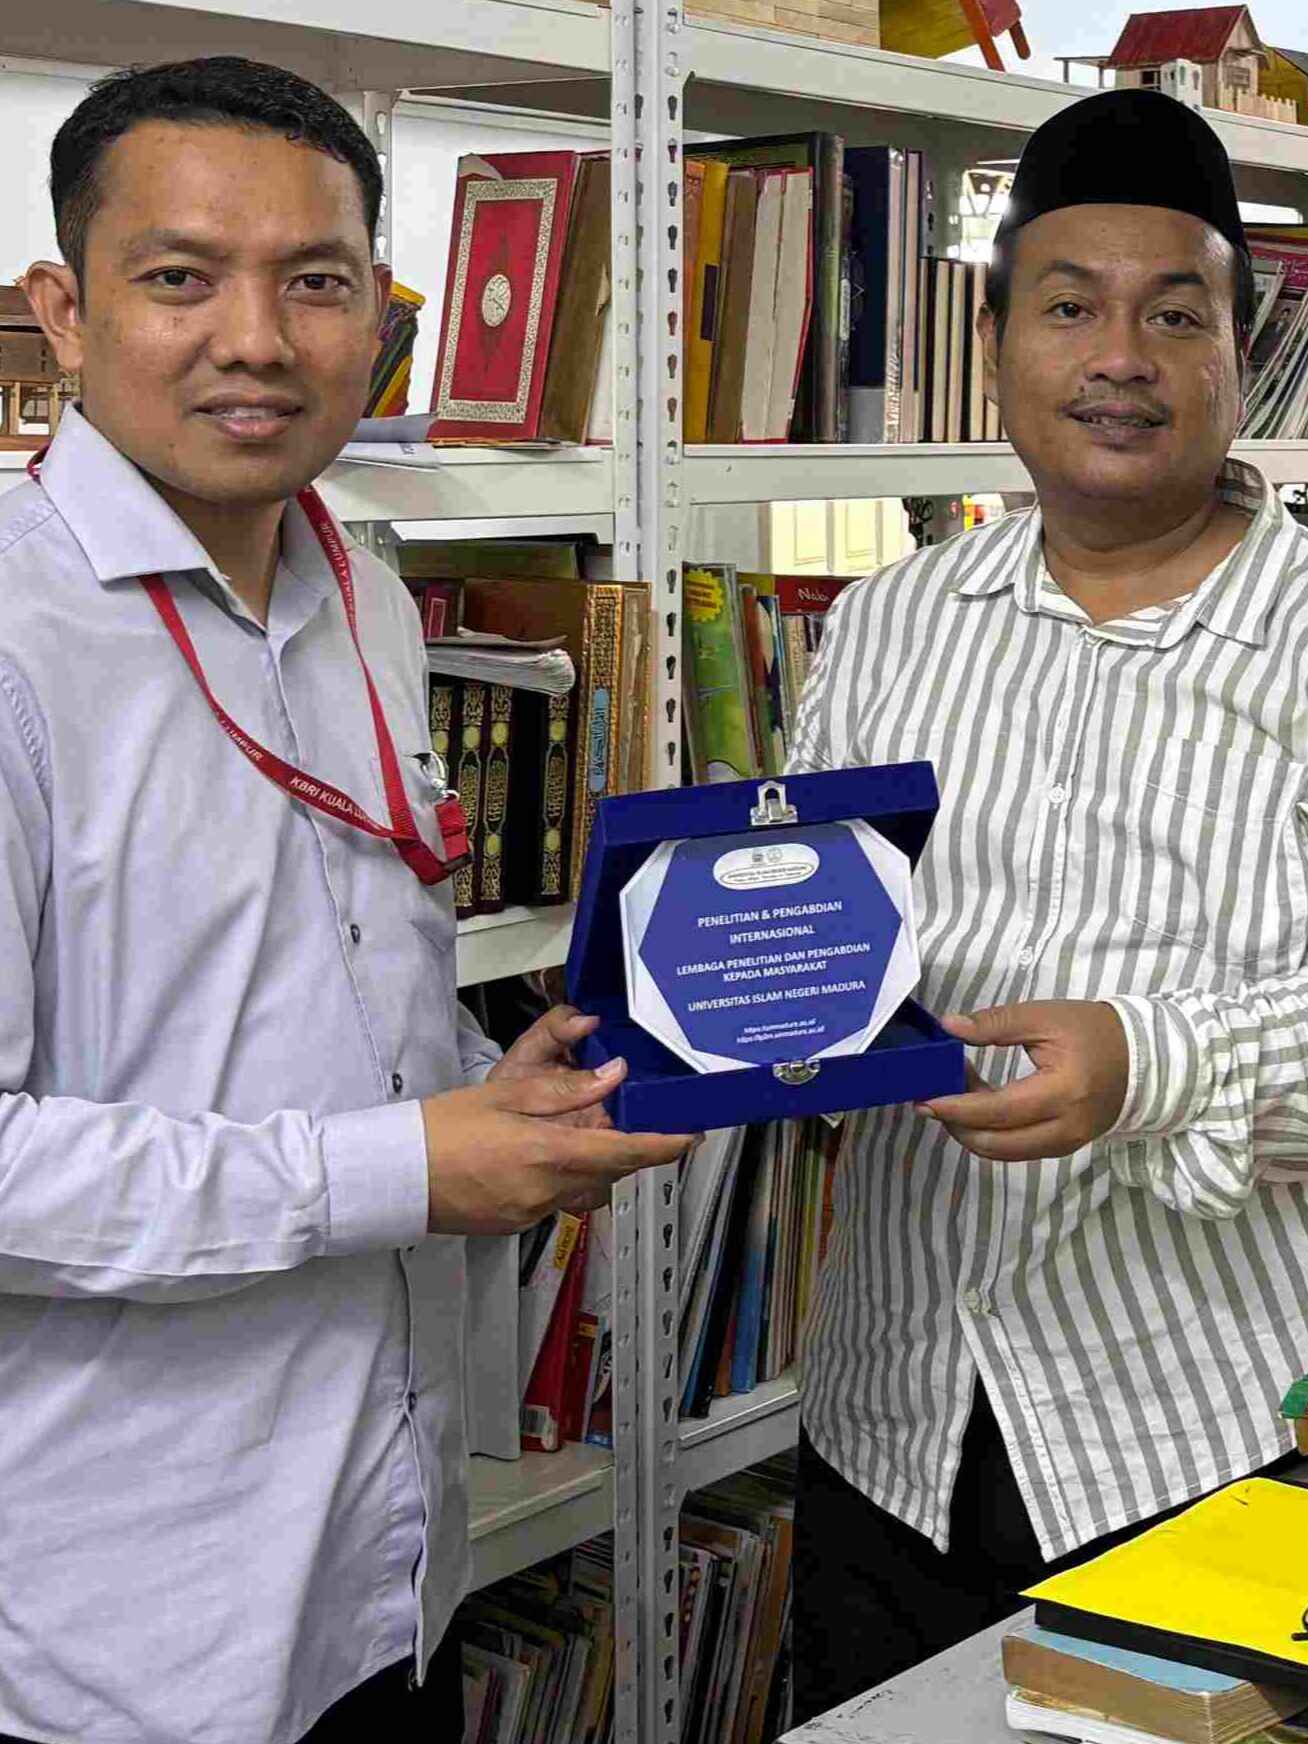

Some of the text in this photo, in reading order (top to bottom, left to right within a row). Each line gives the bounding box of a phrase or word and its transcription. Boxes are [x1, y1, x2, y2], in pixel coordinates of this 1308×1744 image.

[289, 776, 320, 798] KBRI
[323, 789, 354, 815] KUALA
[697, 900, 843, 928] PENELITIAN & PENGABDIAN
[729, 924, 816, 945] INTERNASIONAL
[676, 942, 871, 977] LEMBAGA PENELITIAN DAN PENGABDIAN
[722, 960, 828, 983] KEPADA MASYARAKAT
[688, 980, 867, 1012] UNIVERSITAS ISLAM NEGERI MADURA
